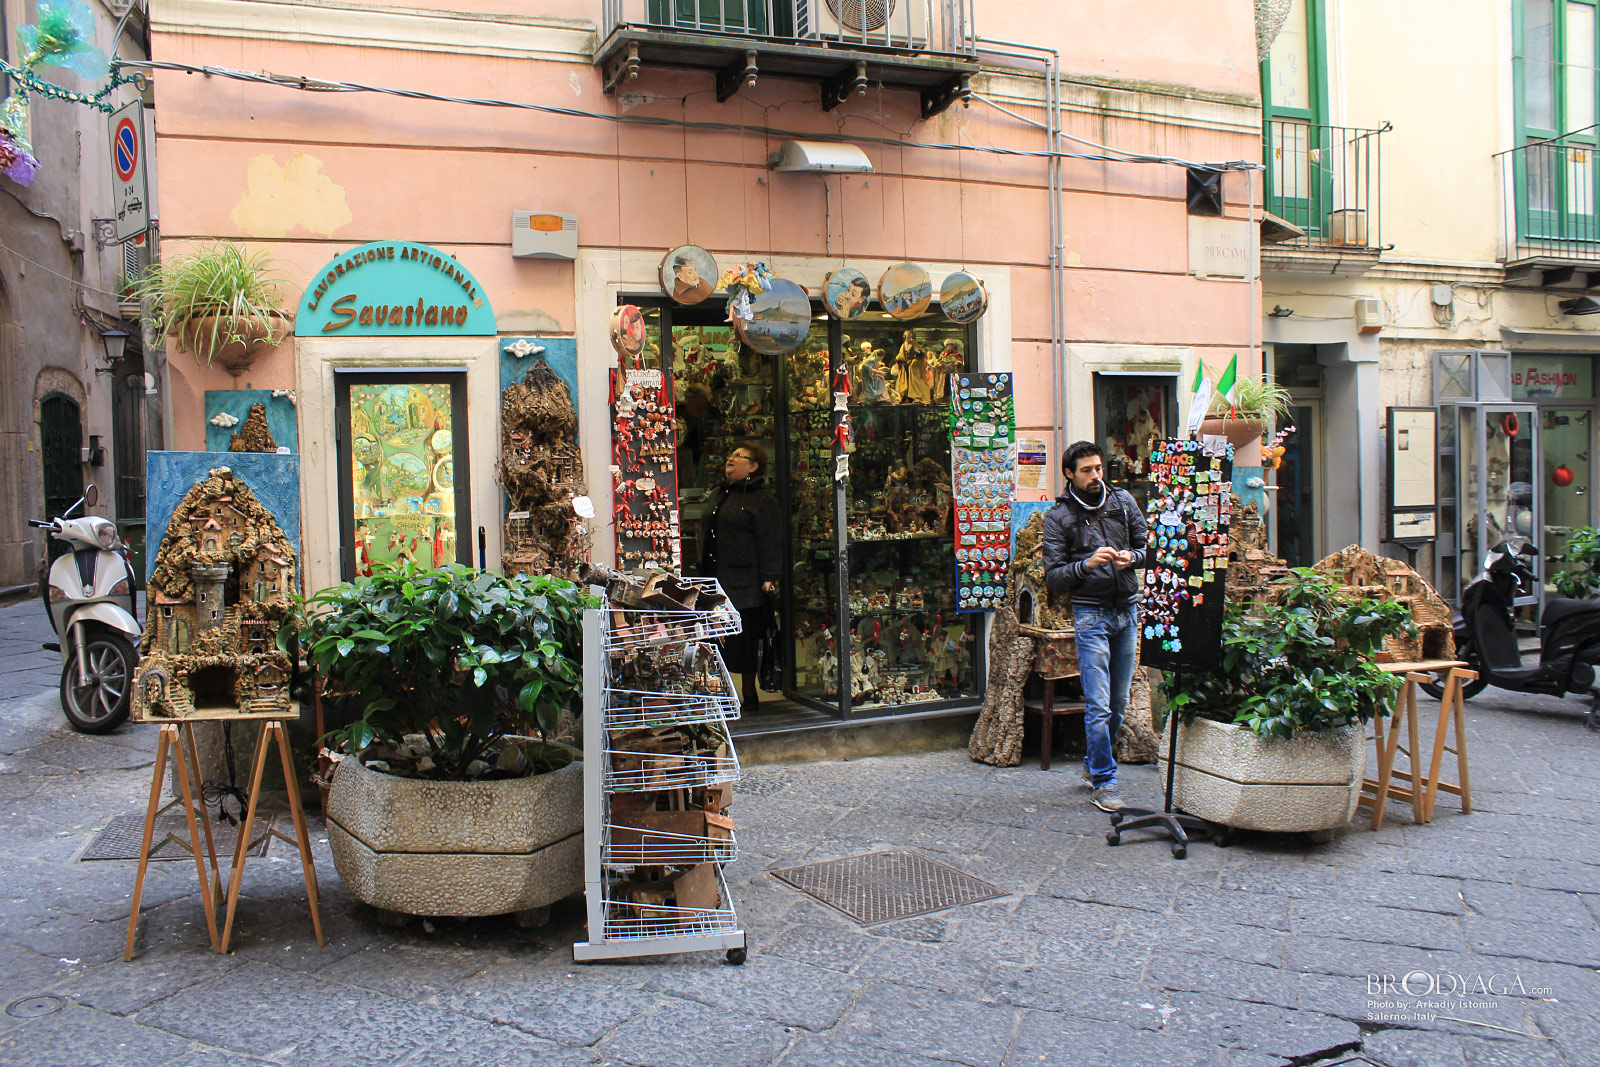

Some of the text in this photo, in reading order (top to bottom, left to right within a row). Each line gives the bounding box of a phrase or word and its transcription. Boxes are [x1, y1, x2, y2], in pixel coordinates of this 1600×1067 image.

[308, 246, 484, 311] LAVORAZIONE ARTIGIANALE
[322, 293, 468, 332] Savastano
